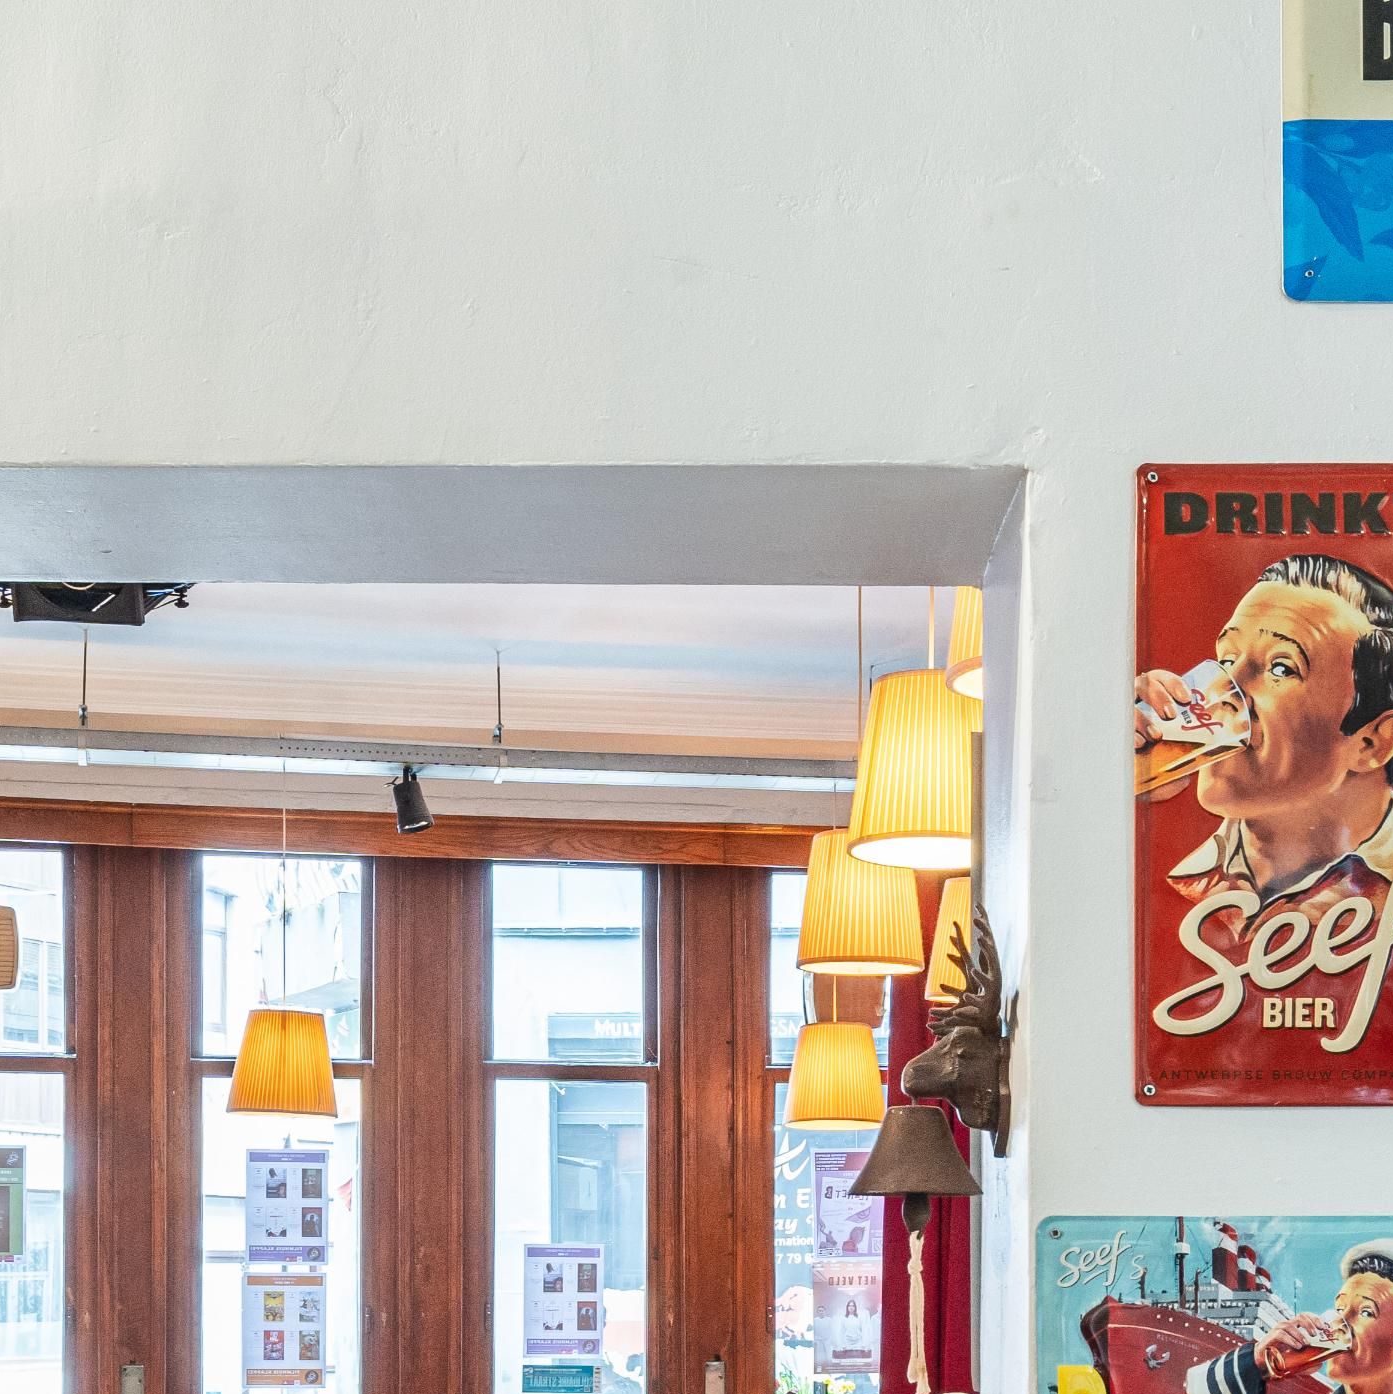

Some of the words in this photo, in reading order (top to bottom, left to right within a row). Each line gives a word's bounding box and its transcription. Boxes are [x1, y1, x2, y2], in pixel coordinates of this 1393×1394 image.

[1262, 997, 1338, 1028] BIER
[1271, 1069, 1332, 1081] BROUW
[1056, 1229, 1134, 1289] Seef
